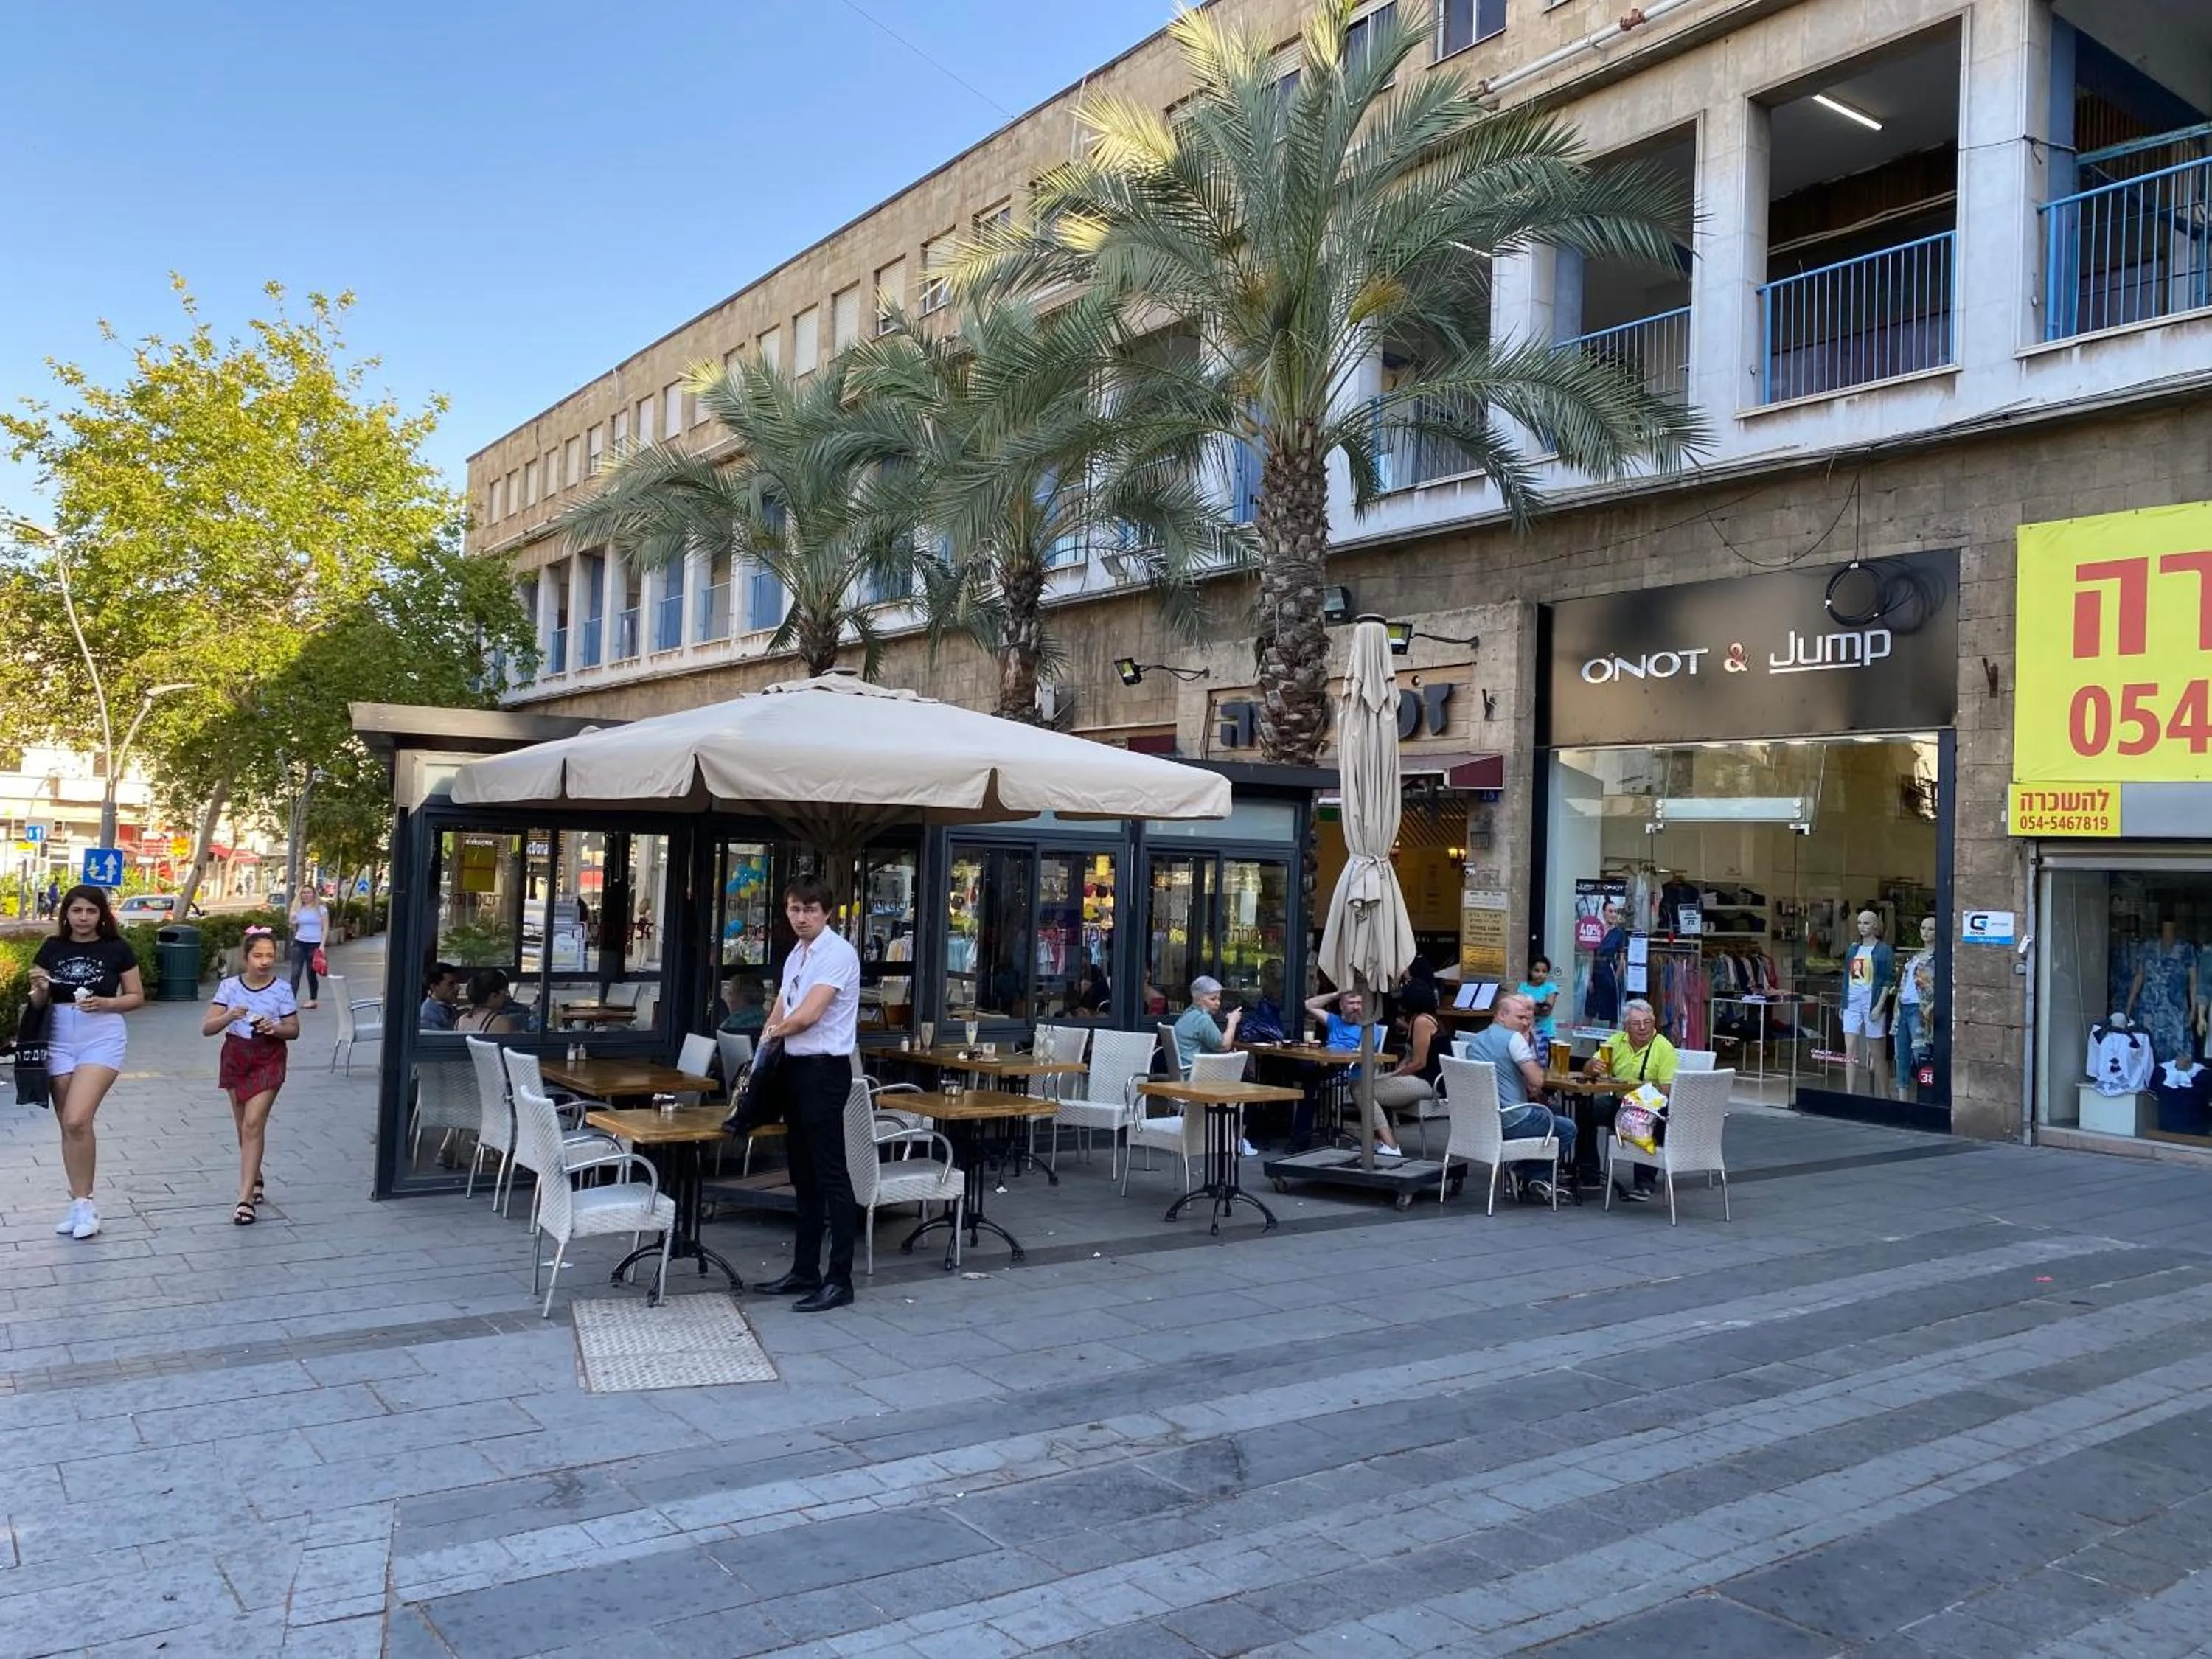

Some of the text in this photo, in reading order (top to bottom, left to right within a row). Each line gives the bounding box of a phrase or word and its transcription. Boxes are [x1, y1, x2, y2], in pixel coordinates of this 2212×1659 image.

[1723, 641, 1750, 673] &
[1769, 628, 1892, 669] Jump
[2020, 788, 2110, 812] להשכרה
[2020, 816, 2109, 831] 054-5467819
